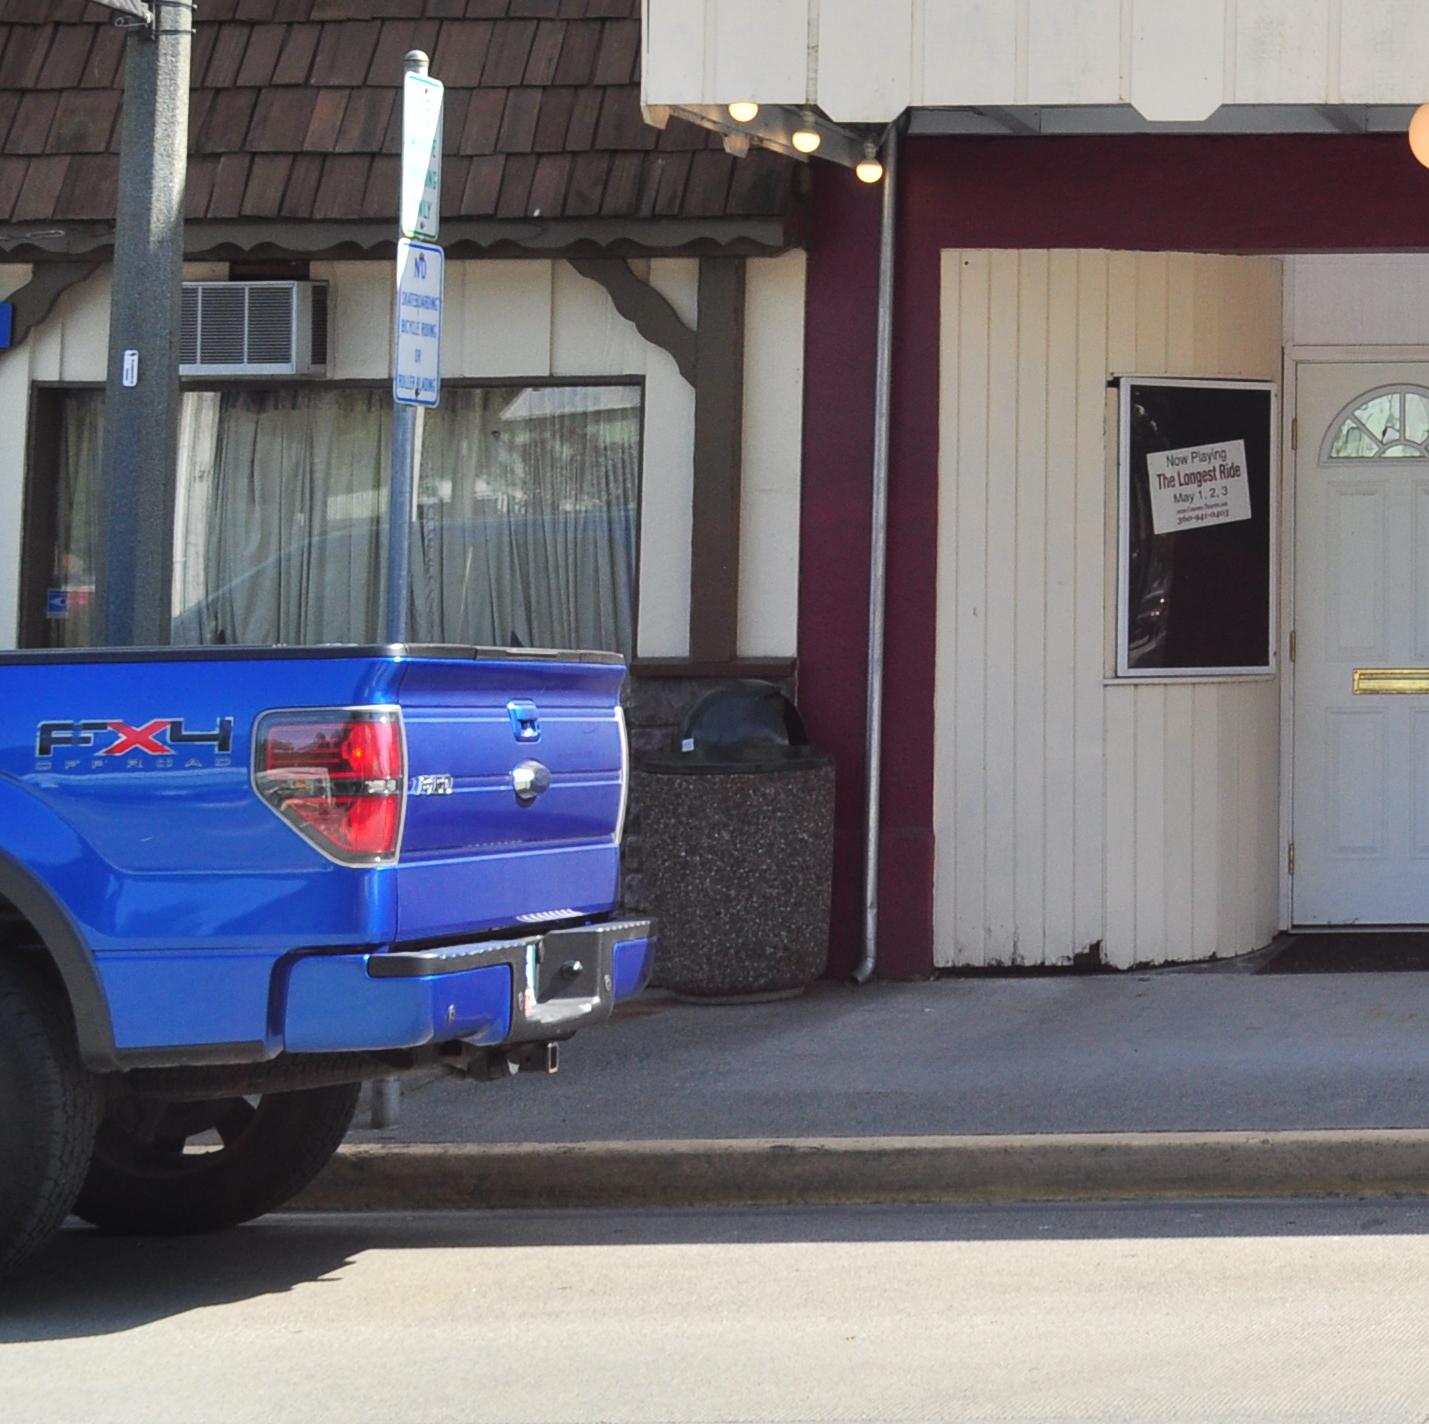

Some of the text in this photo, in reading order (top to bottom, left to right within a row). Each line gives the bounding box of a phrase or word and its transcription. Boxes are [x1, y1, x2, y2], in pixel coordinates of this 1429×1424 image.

[1166, 449, 1227, 468] Now Playing
[1156, 462, 1241, 490] The Longest Ride
[1173, 492, 1194, 505] May
[1221, 486, 1229, 496] 3
